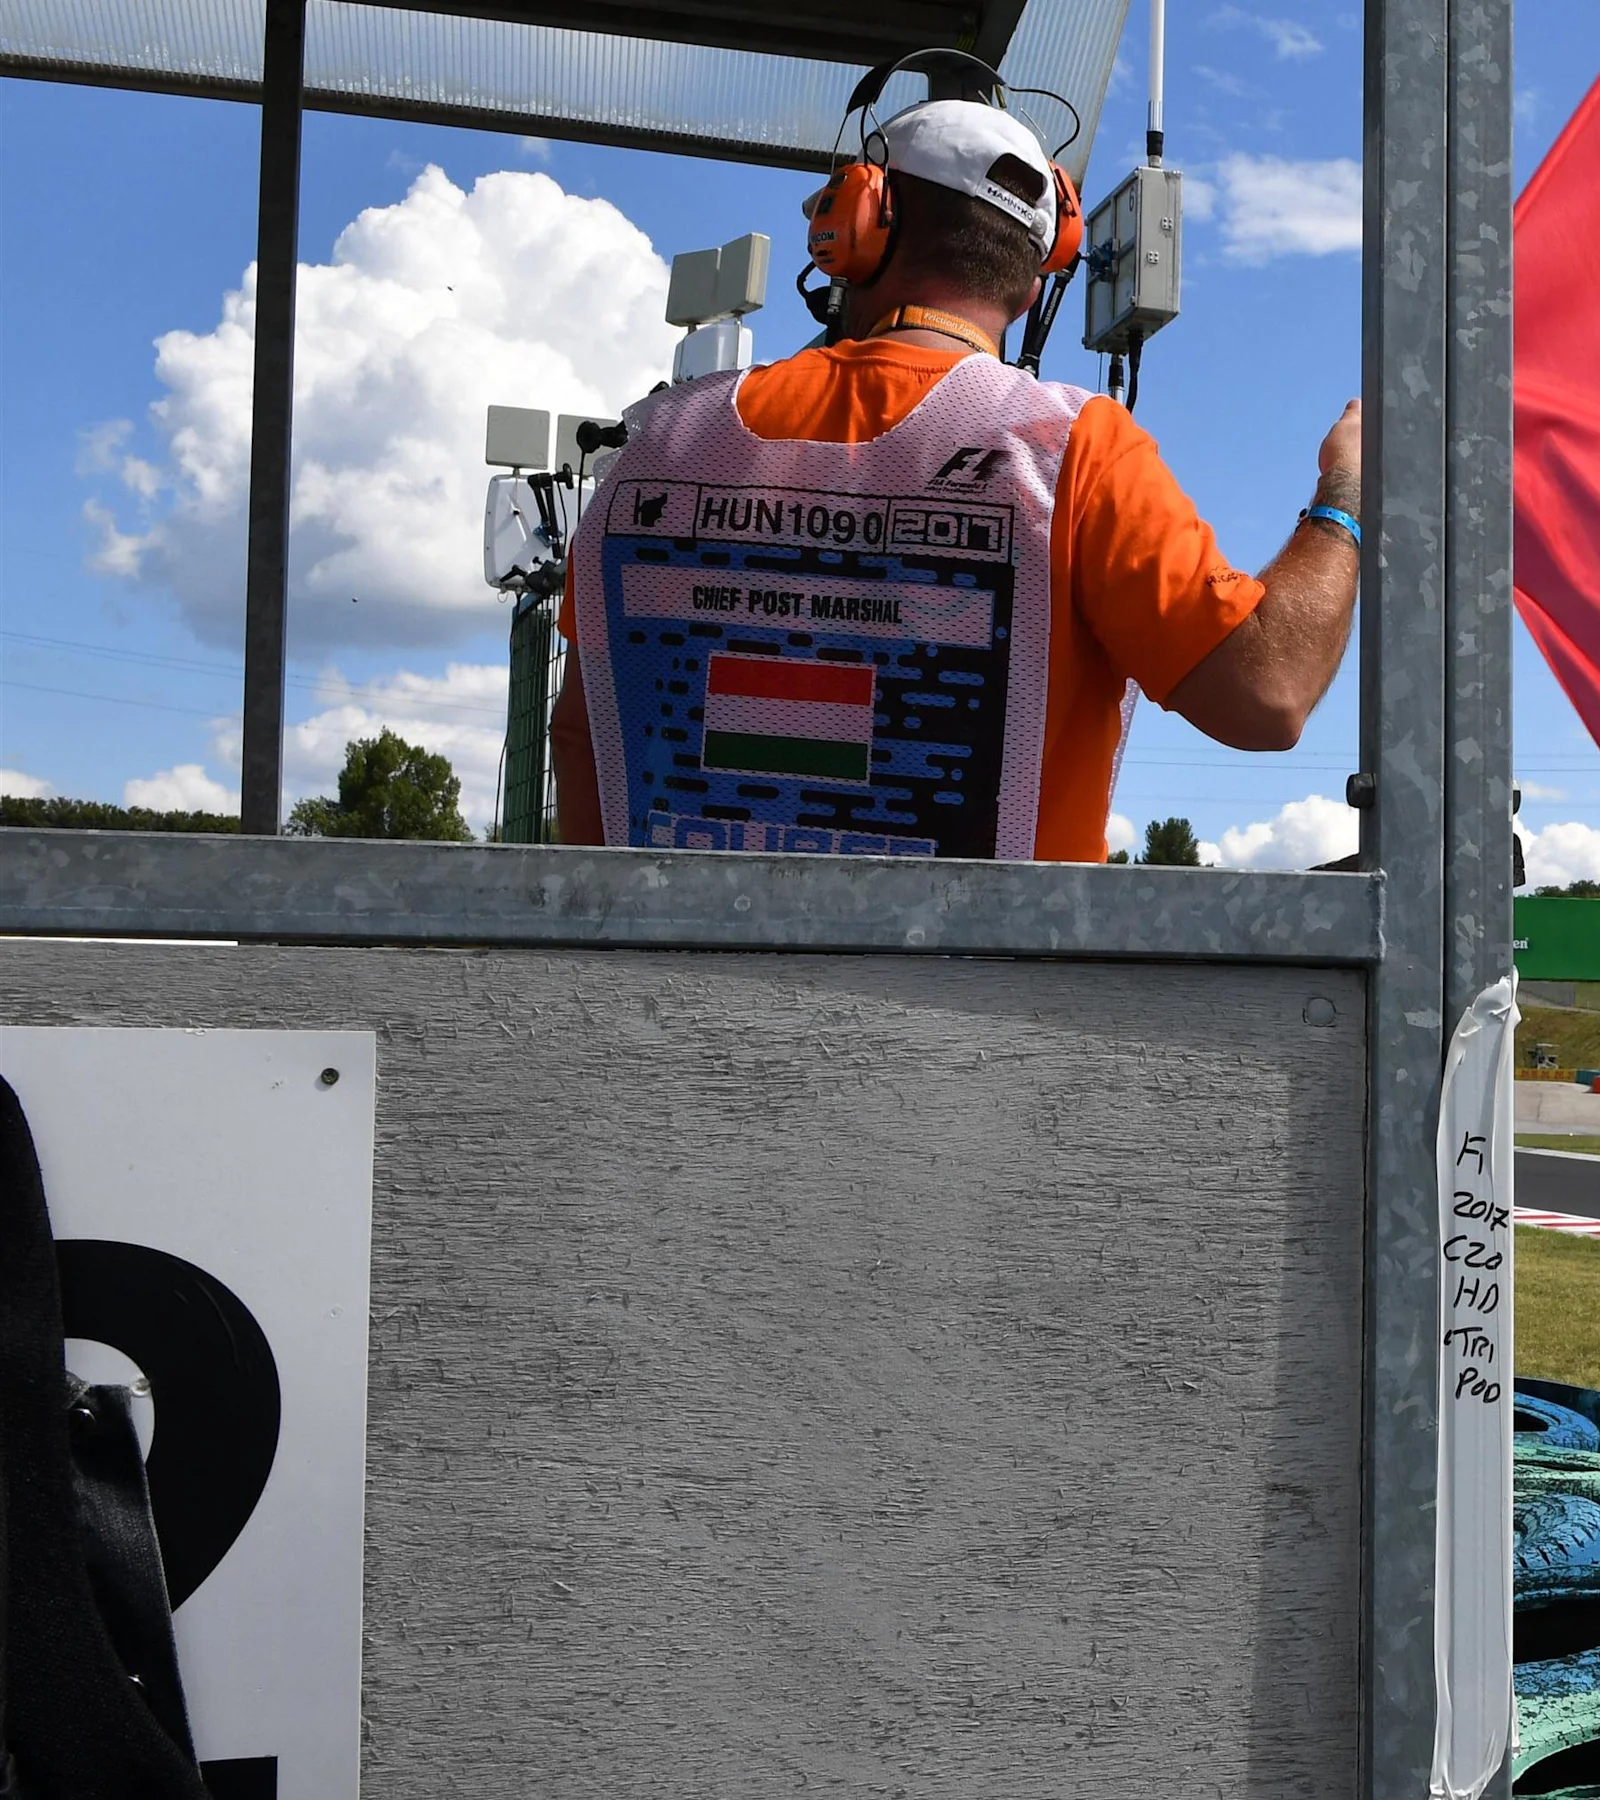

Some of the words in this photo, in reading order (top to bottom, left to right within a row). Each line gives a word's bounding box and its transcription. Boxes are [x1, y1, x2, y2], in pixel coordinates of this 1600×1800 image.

[1128, 187, 1136, 212] 6
[892, 509, 1003, 553] 2017
[692, 585, 742, 612] CHIEF
[748, 589, 805, 617] POST
[811, 594, 903, 624] MARSHAL
[1453, 1191, 1510, 1232] 2017
[1453, 1275, 1499, 1314] HD
